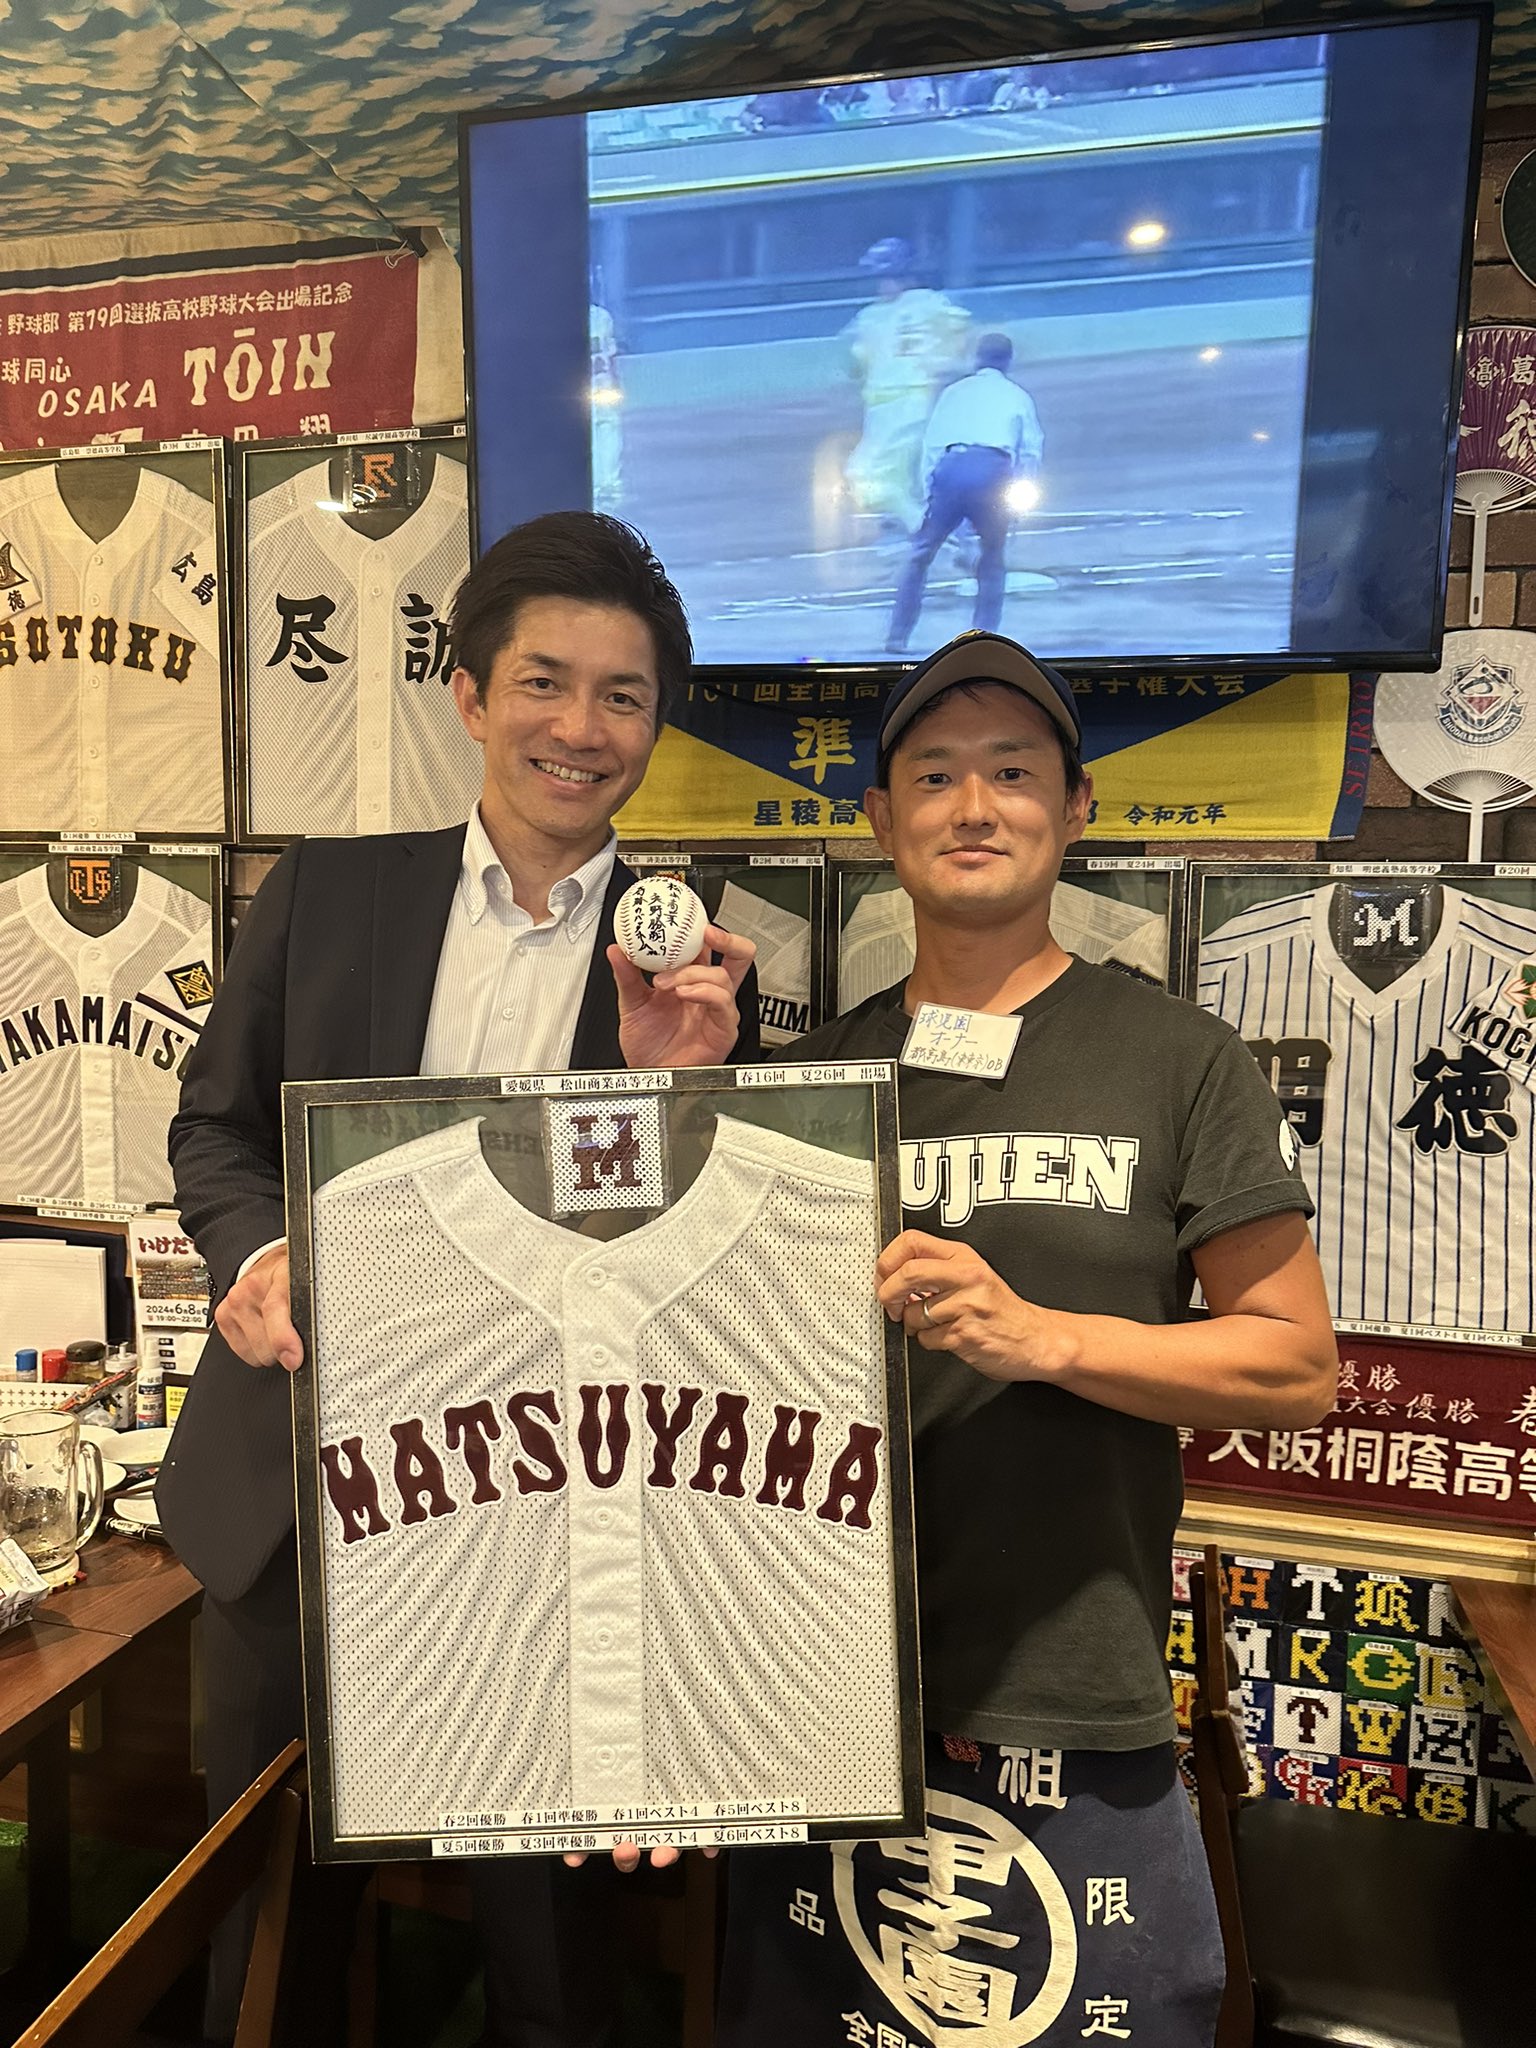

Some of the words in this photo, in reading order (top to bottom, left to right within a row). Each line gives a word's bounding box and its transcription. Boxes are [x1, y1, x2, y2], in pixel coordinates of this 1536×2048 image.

[37, 379, 158, 419] OSAKA
[171, 551, 217, 606] 広島
[264, 592, 351, 684] 尽
[788, 715, 857, 786] 準
[1345, 680, 1375, 799] SEIRYO
[1122, 803, 1228, 826] 令和元年
[1352, 897, 1419, 947] M
[930, 1031, 979, 1050] オーナー
[505, 1078, 546, 1093] 愛媛県
[560, 1073, 671, 1091] 松山商業高等学校
[740, 1070, 786, 1085] 春16回
[801, 1068, 846, 1083] 夏26回
[860, 1066, 887, 1081] 出場
[1394, 1043, 1520, 1156] 徳
[321, 1381, 884, 1546] MATSUYAMA
[1286, 1695, 1330, 1744] T
[997, 1744, 1069, 1810] 祖
[443, 1811, 507, 1828] 春2回優勝
[520, 1808, 599, 1826] 春1回準優勝
[612, 1805, 699, 1822] 春1回ベスト4
[714, 1800, 801, 1817] 春5回ベスト8
[440, 1837, 505, 1853] 夏5回優勝
[519, 1835, 597, 1851] 夏3回準優勝
[713, 1826, 801, 1844] 夏6回ベスト8
[788, 1887, 826, 1937] 品
